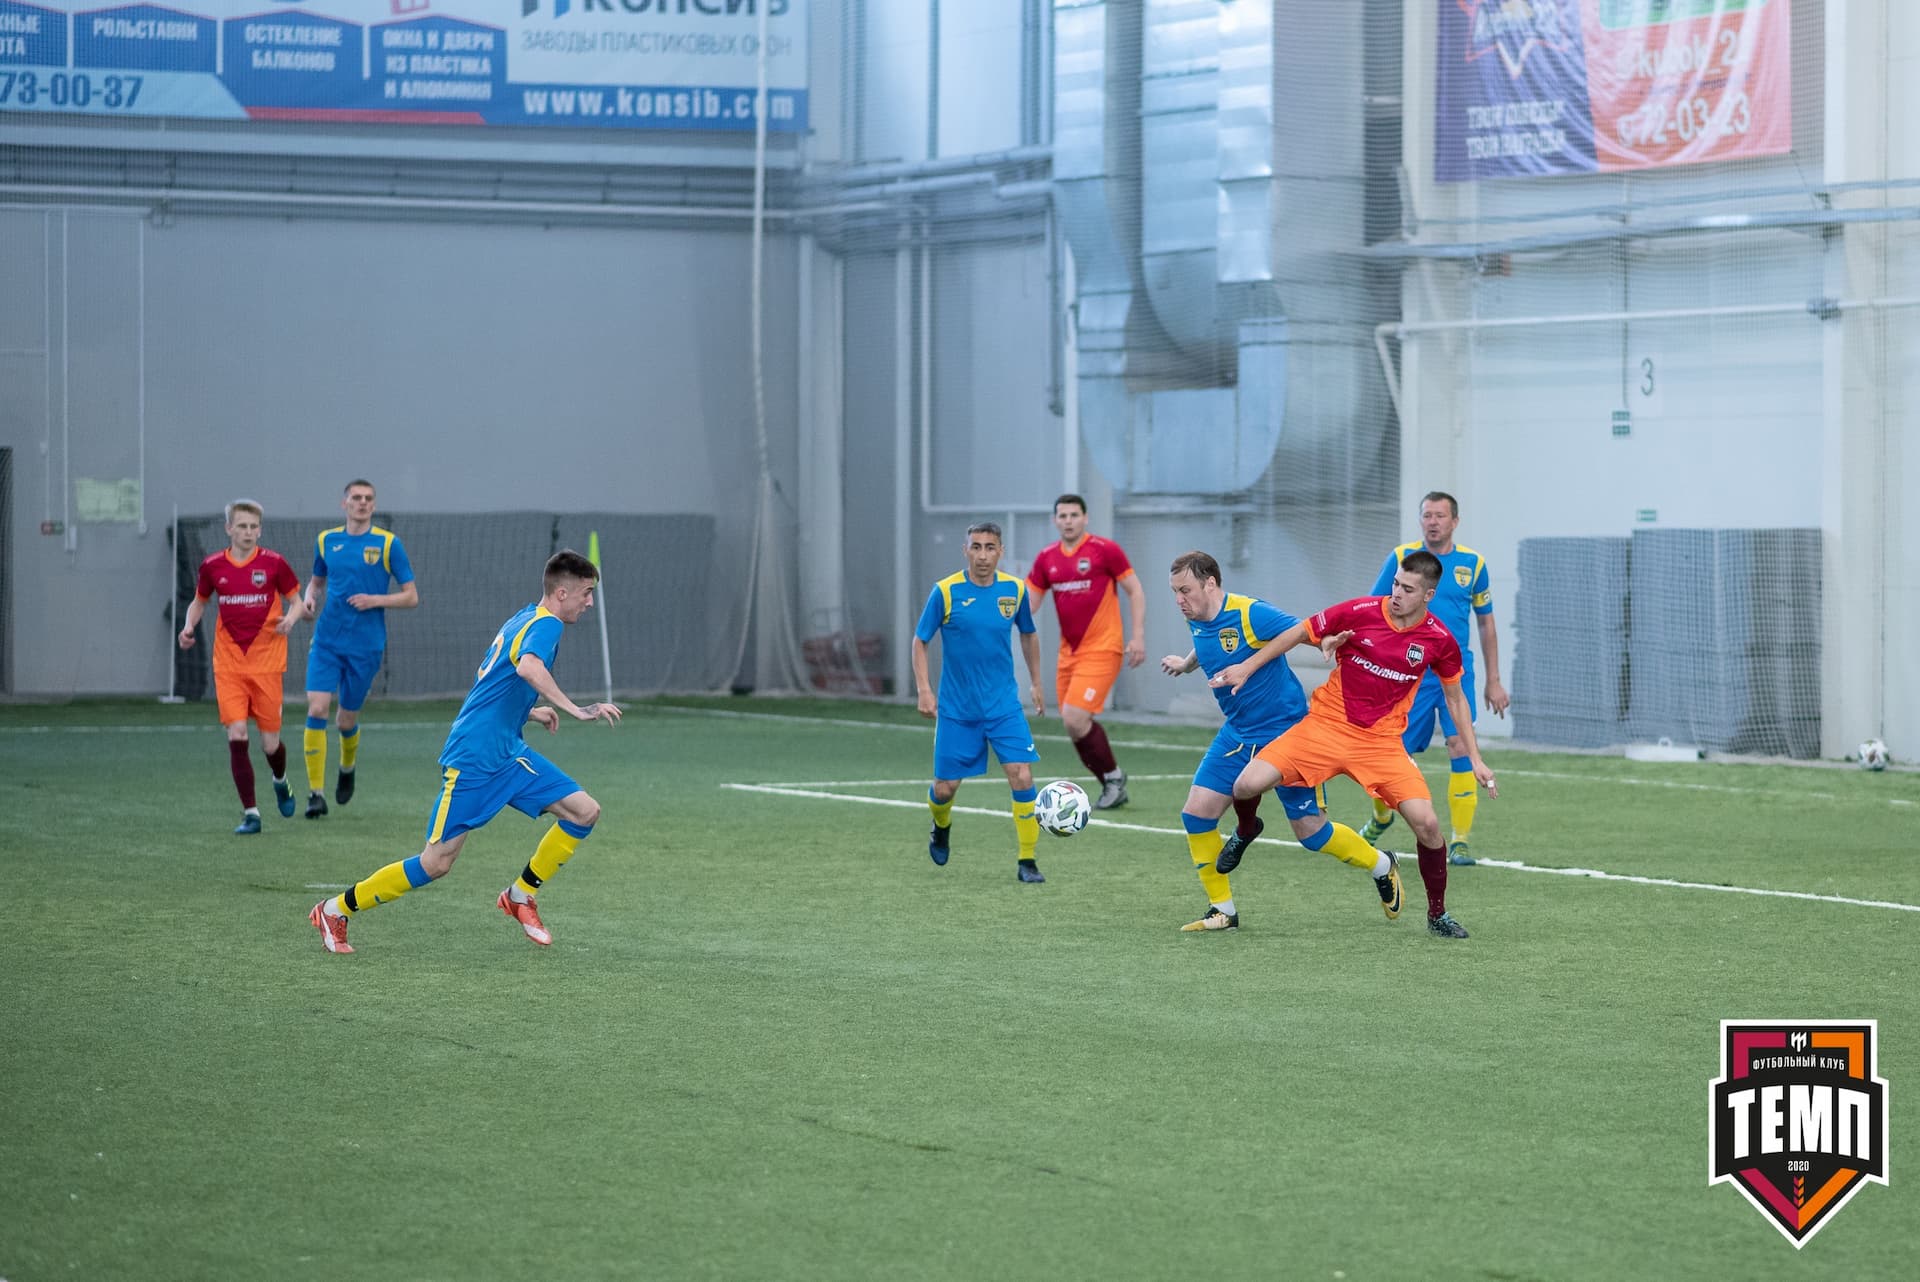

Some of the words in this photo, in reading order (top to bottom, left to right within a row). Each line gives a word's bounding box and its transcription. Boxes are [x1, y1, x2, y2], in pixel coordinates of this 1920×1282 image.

[93, 18, 197, 41] РОЛЬСТАВНИ
[245, 24, 341, 46] ОСТЕКЛЕНИЕ
[383, 29, 424, 48] ОКНА
[427, 30, 439, 49] И
[443, 31, 494, 51] ДВЕРИ
[521, 30, 598, 53] ЗАВОДЫ
[601, 31, 738, 56] ПЛАСТИКОВЫХ
[742, 33, 793, 56] ООН
[252, 50, 335, 71] БАЛКОНОВ
[385, 54, 407, 73] ИЗ
[410, 55, 492, 75] ПЛАСТИКА
[384, 79, 396, 98] И
[1641, 358, 1654, 396] 3
